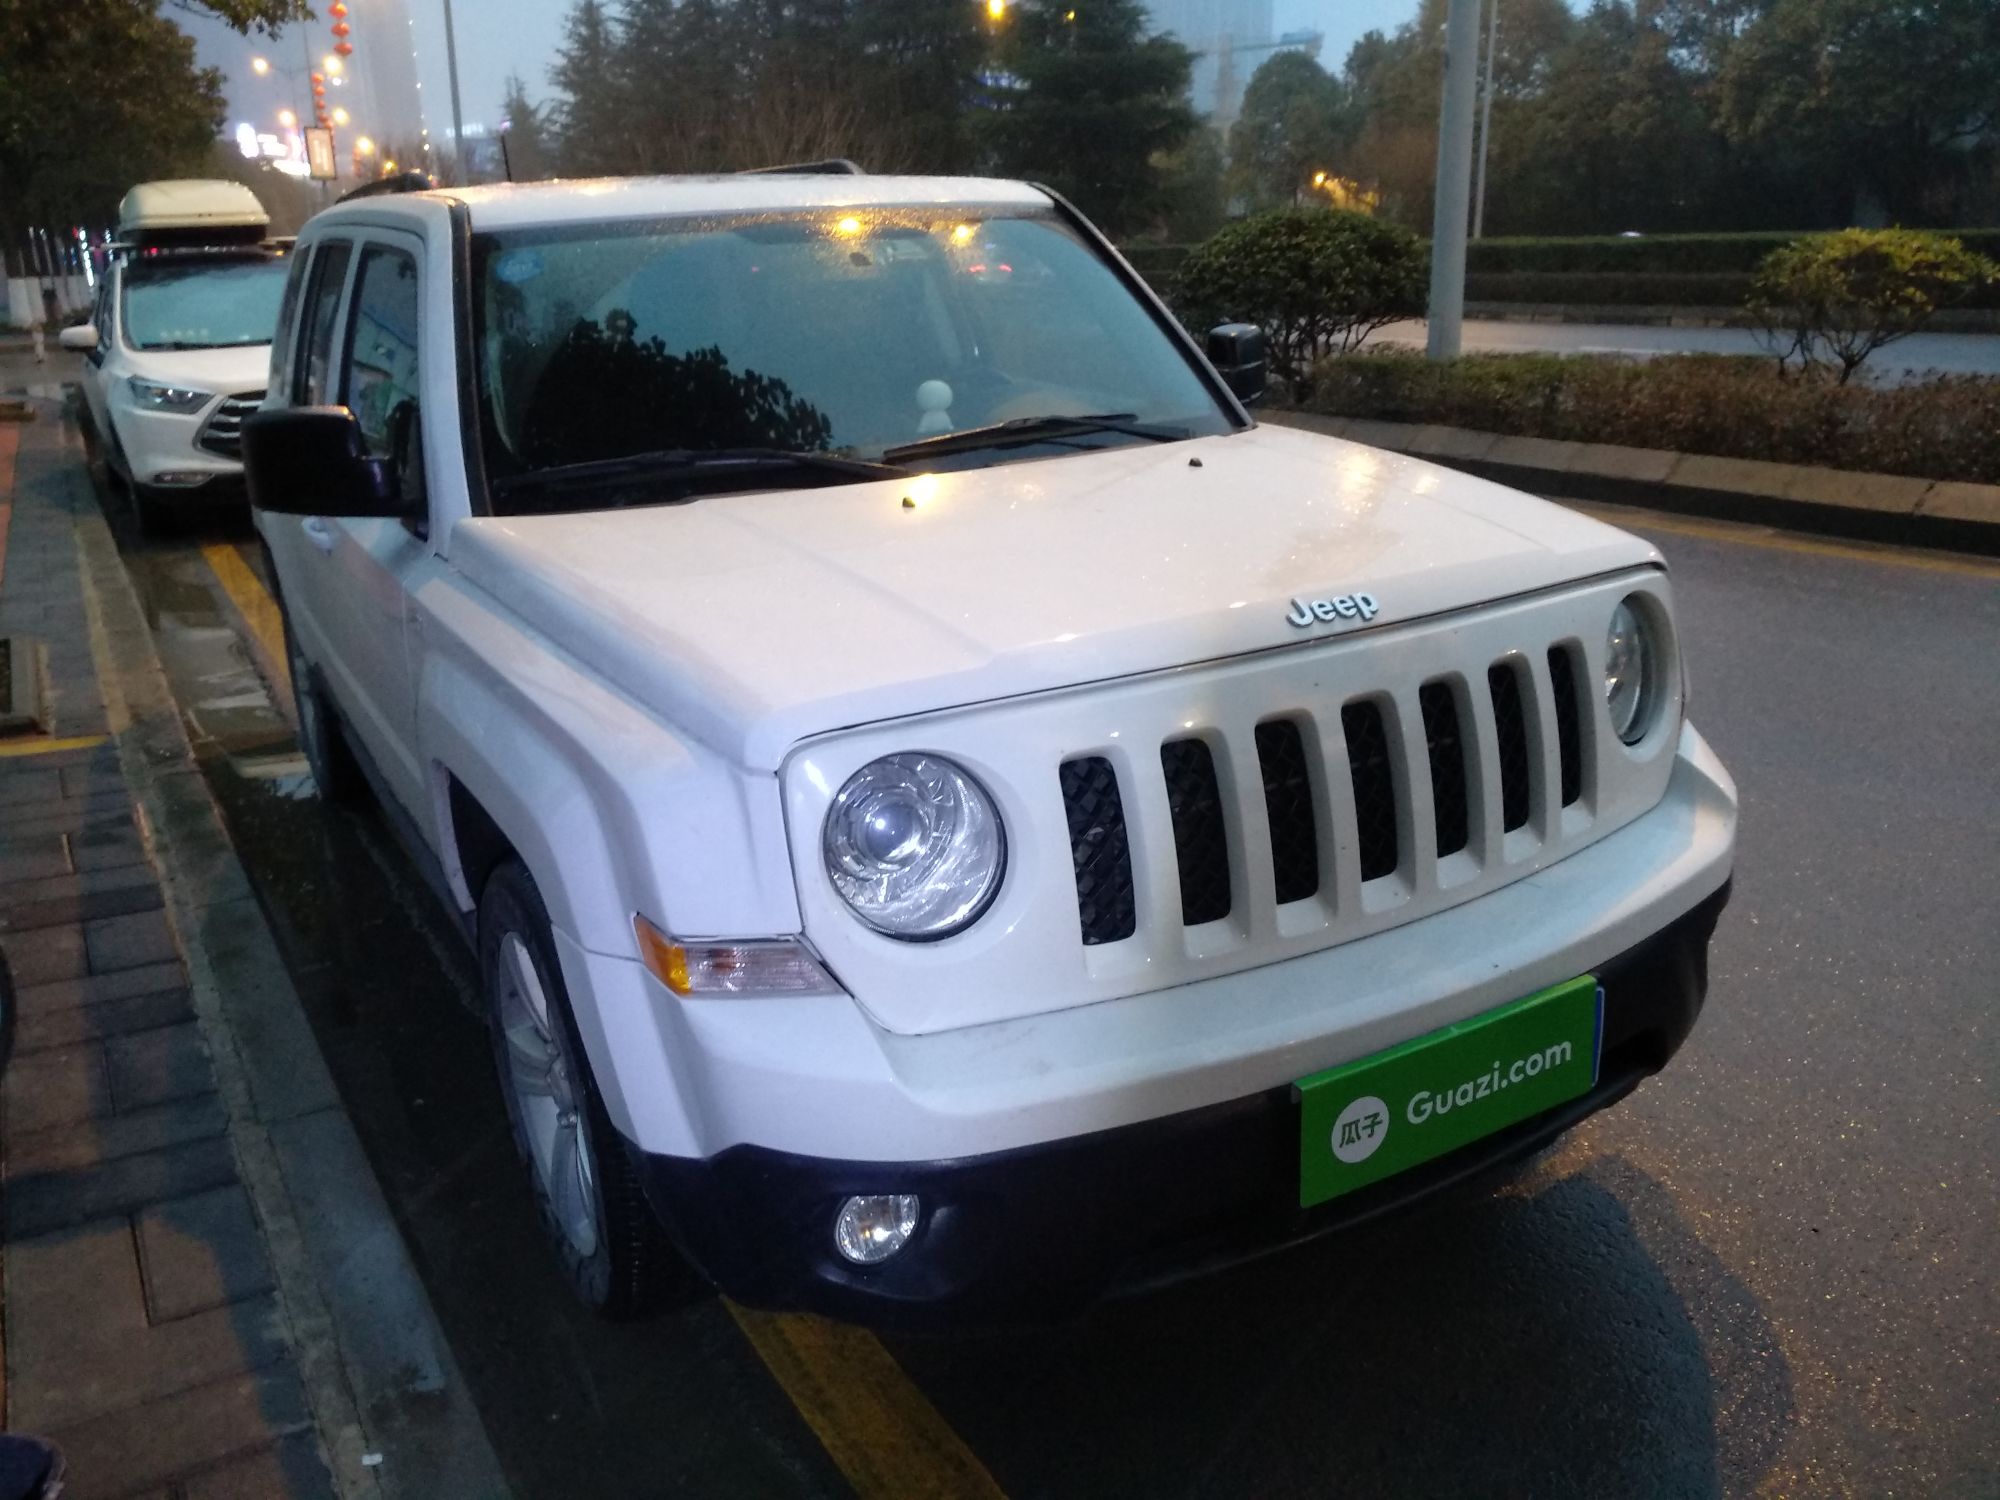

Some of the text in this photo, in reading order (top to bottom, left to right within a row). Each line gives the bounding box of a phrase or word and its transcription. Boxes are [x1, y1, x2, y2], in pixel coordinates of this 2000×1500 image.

[1286, 591, 1379, 627] Jeep
[1407, 1041, 1571, 1125] Guazi.com
[1339, 1112, 1383, 1148] 瓜子
